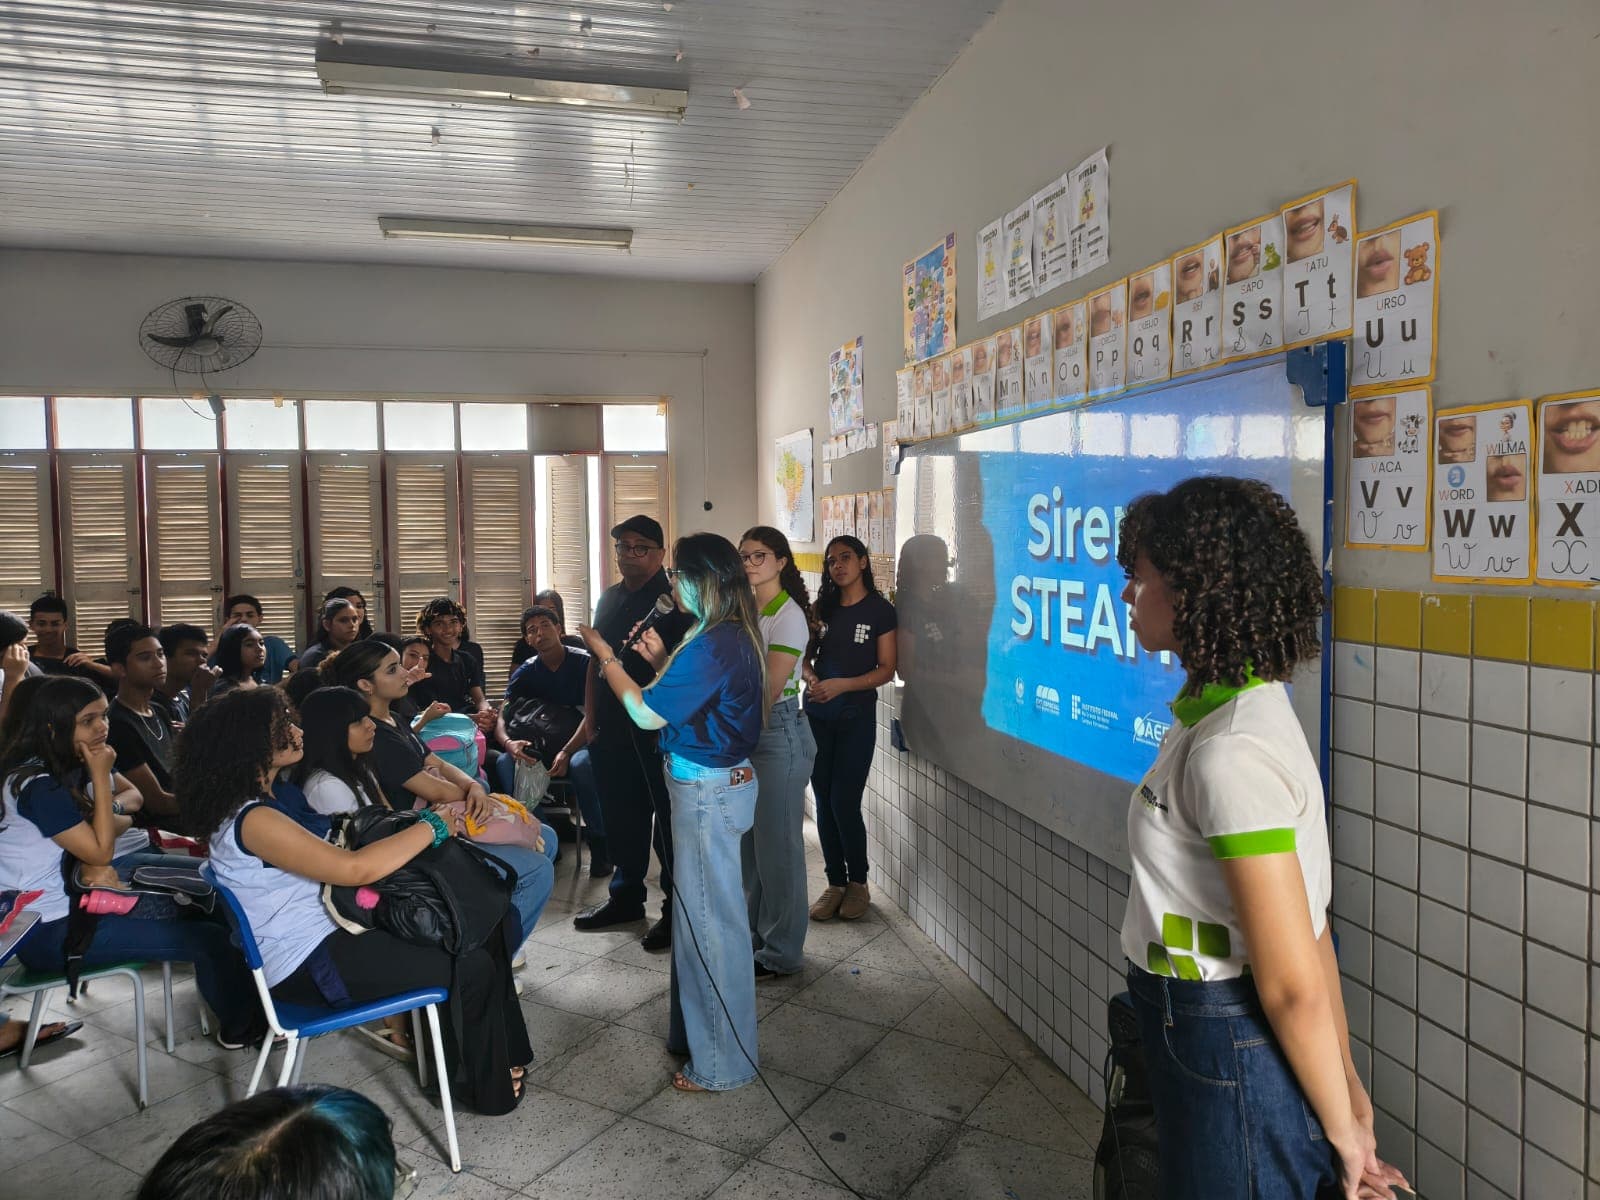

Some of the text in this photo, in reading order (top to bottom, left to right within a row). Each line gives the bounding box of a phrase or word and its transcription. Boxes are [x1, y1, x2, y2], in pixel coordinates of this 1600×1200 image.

[1305, 256, 1328, 273] TATU
[1241, 279, 1263, 295] SAPO
[1295, 272, 1336, 307] T t
[1233, 301, 1245, 326] S
[1377, 294, 1406, 311] URSO
[1328, 301, 1336, 329] t
[1182, 315, 1213, 343] R r
[1259, 332, 1272, 347] s
[1366, 318, 1416, 348] U u
[1134, 337, 1143, 357] Q
[1152, 334, 1159, 352] q
[1096, 351, 1103, 371] P
[1112, 349, 1118, 366] p
[1363, 350, 1414, 378] U u
[1029, 370, 1036, 388] N
[1042, 372, 1047, 384] n
[1059, 362, 1079, 381] O o
[1000, 379, 1008, 397] M
[1486, 440, 1526, 454] WILMA
[1370, 461, 1402, 473] VACA
[1360, 480, 1413, 508] V v
[1438, 488, 1475, 500] WORD
[1565, 480, 1600, 494] XAD
[1357, 510, 1418, 539] V v
[1443, 509, 1516, 537] W w
[1556, 502, 1584, 537] X
[1442, 543, 1478, 570] W
